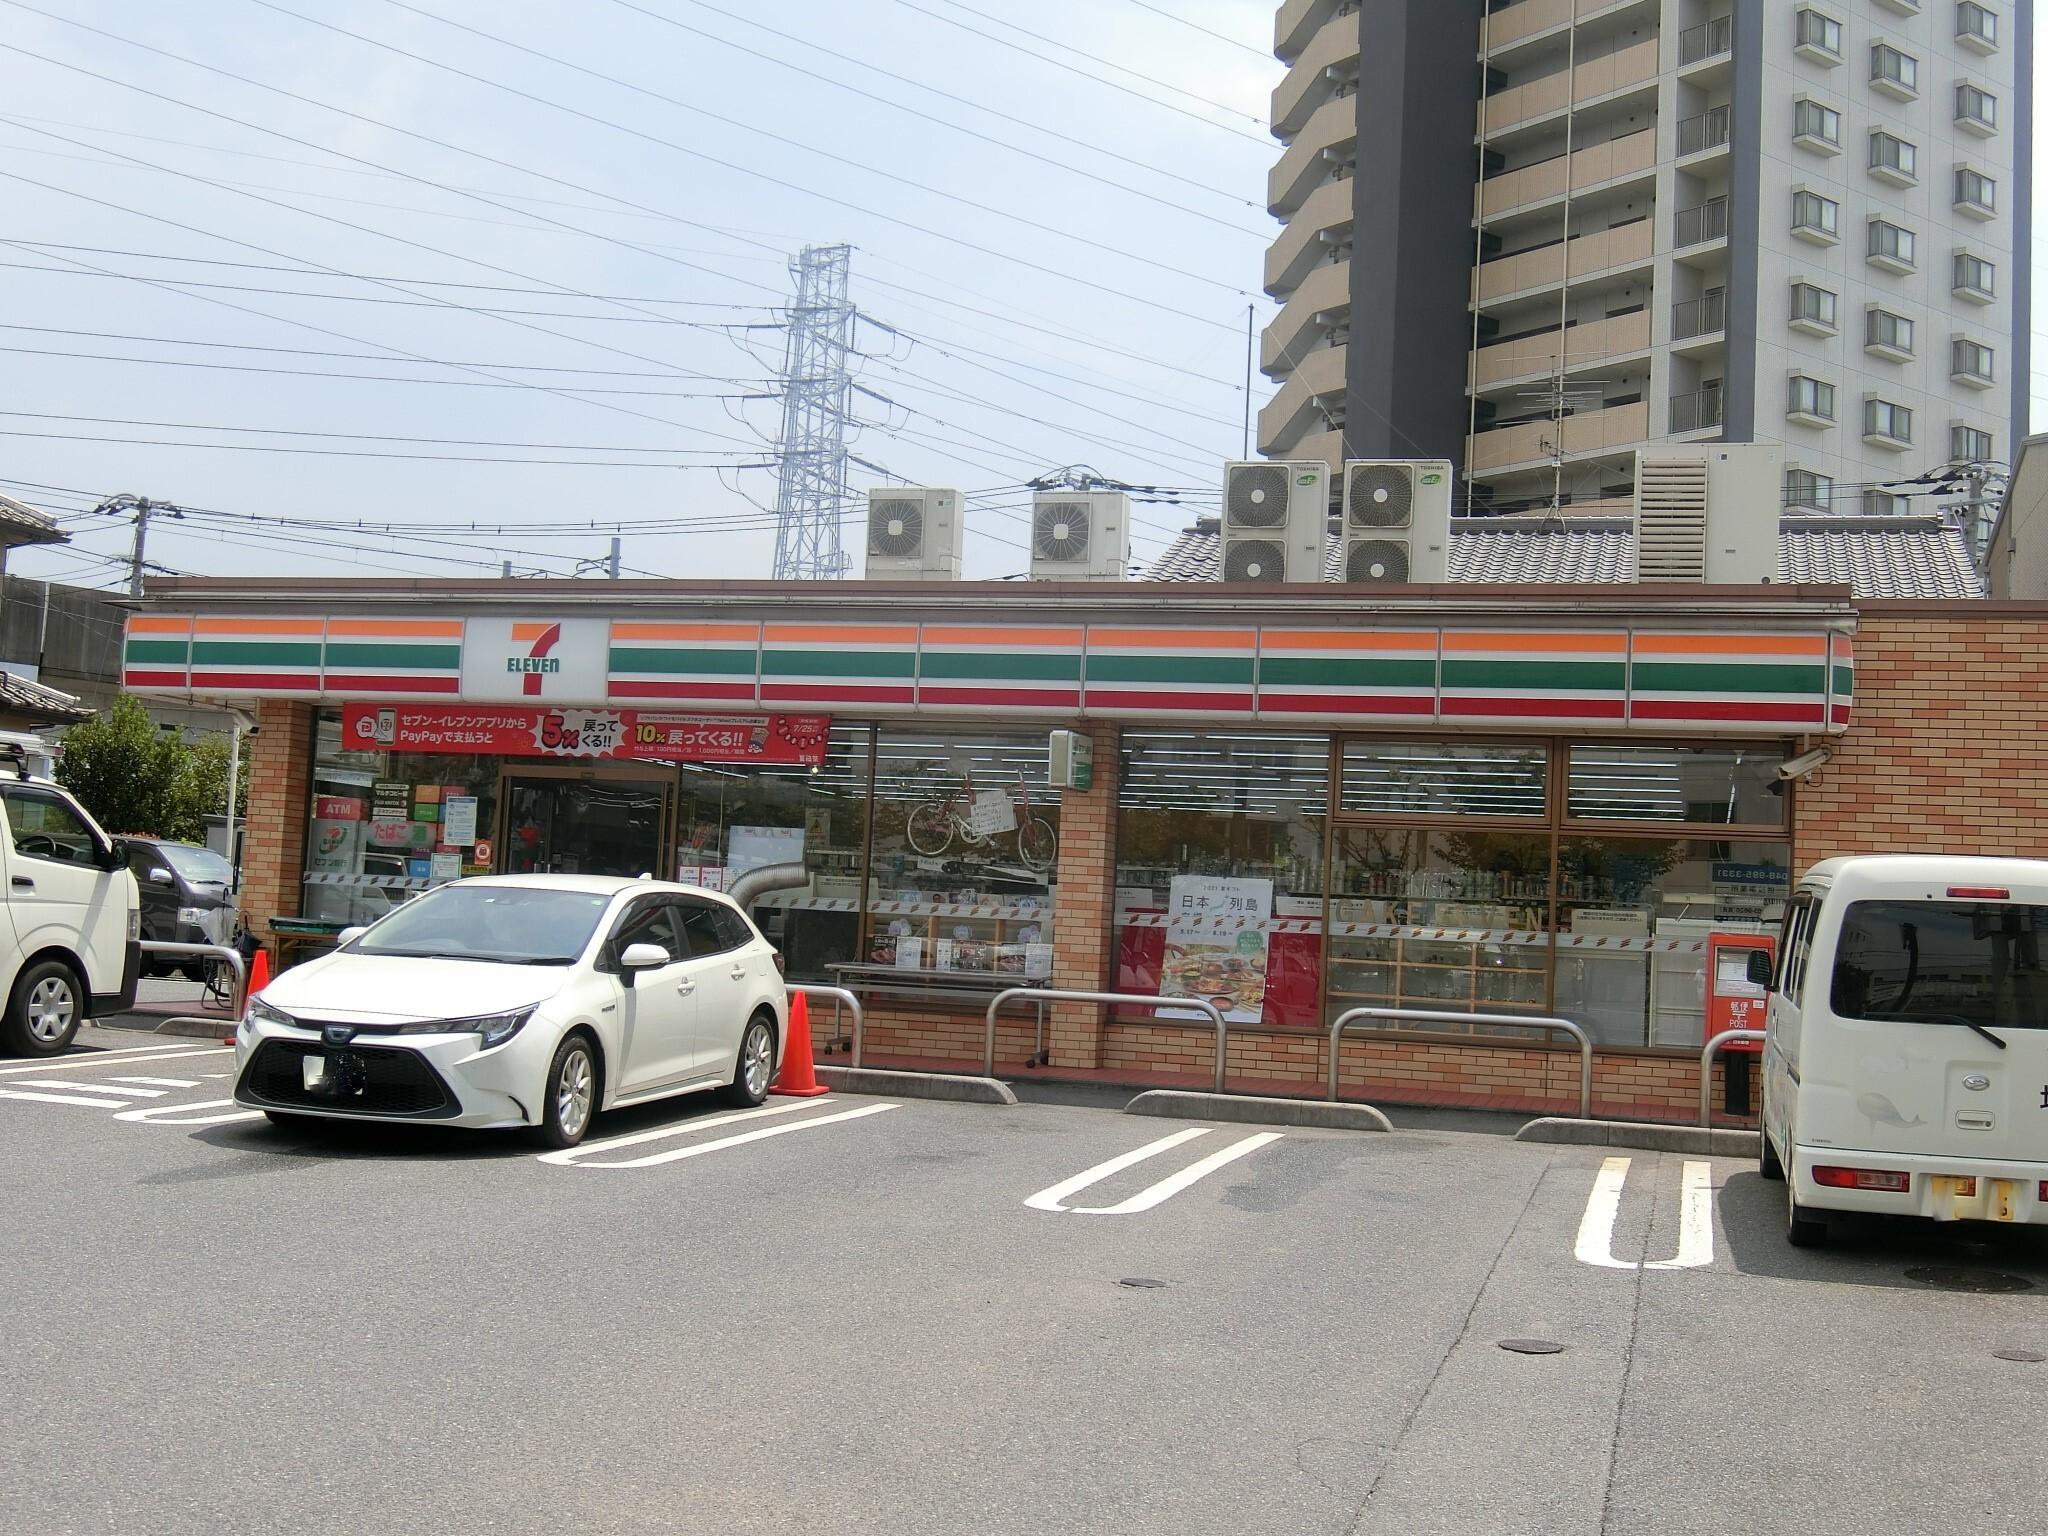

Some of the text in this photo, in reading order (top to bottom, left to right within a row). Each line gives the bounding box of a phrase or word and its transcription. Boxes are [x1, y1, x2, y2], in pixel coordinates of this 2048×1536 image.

[541, 714, 580, 750] 5%
[582, 718, 619, 732] 戻って
[400, 729, 494, 744] PayPayで支払うと
[326, 803, 351, 815] ATM
[374, 823, 408, 841] たばこ
[1729, 1019, 1748, 1029] POST
